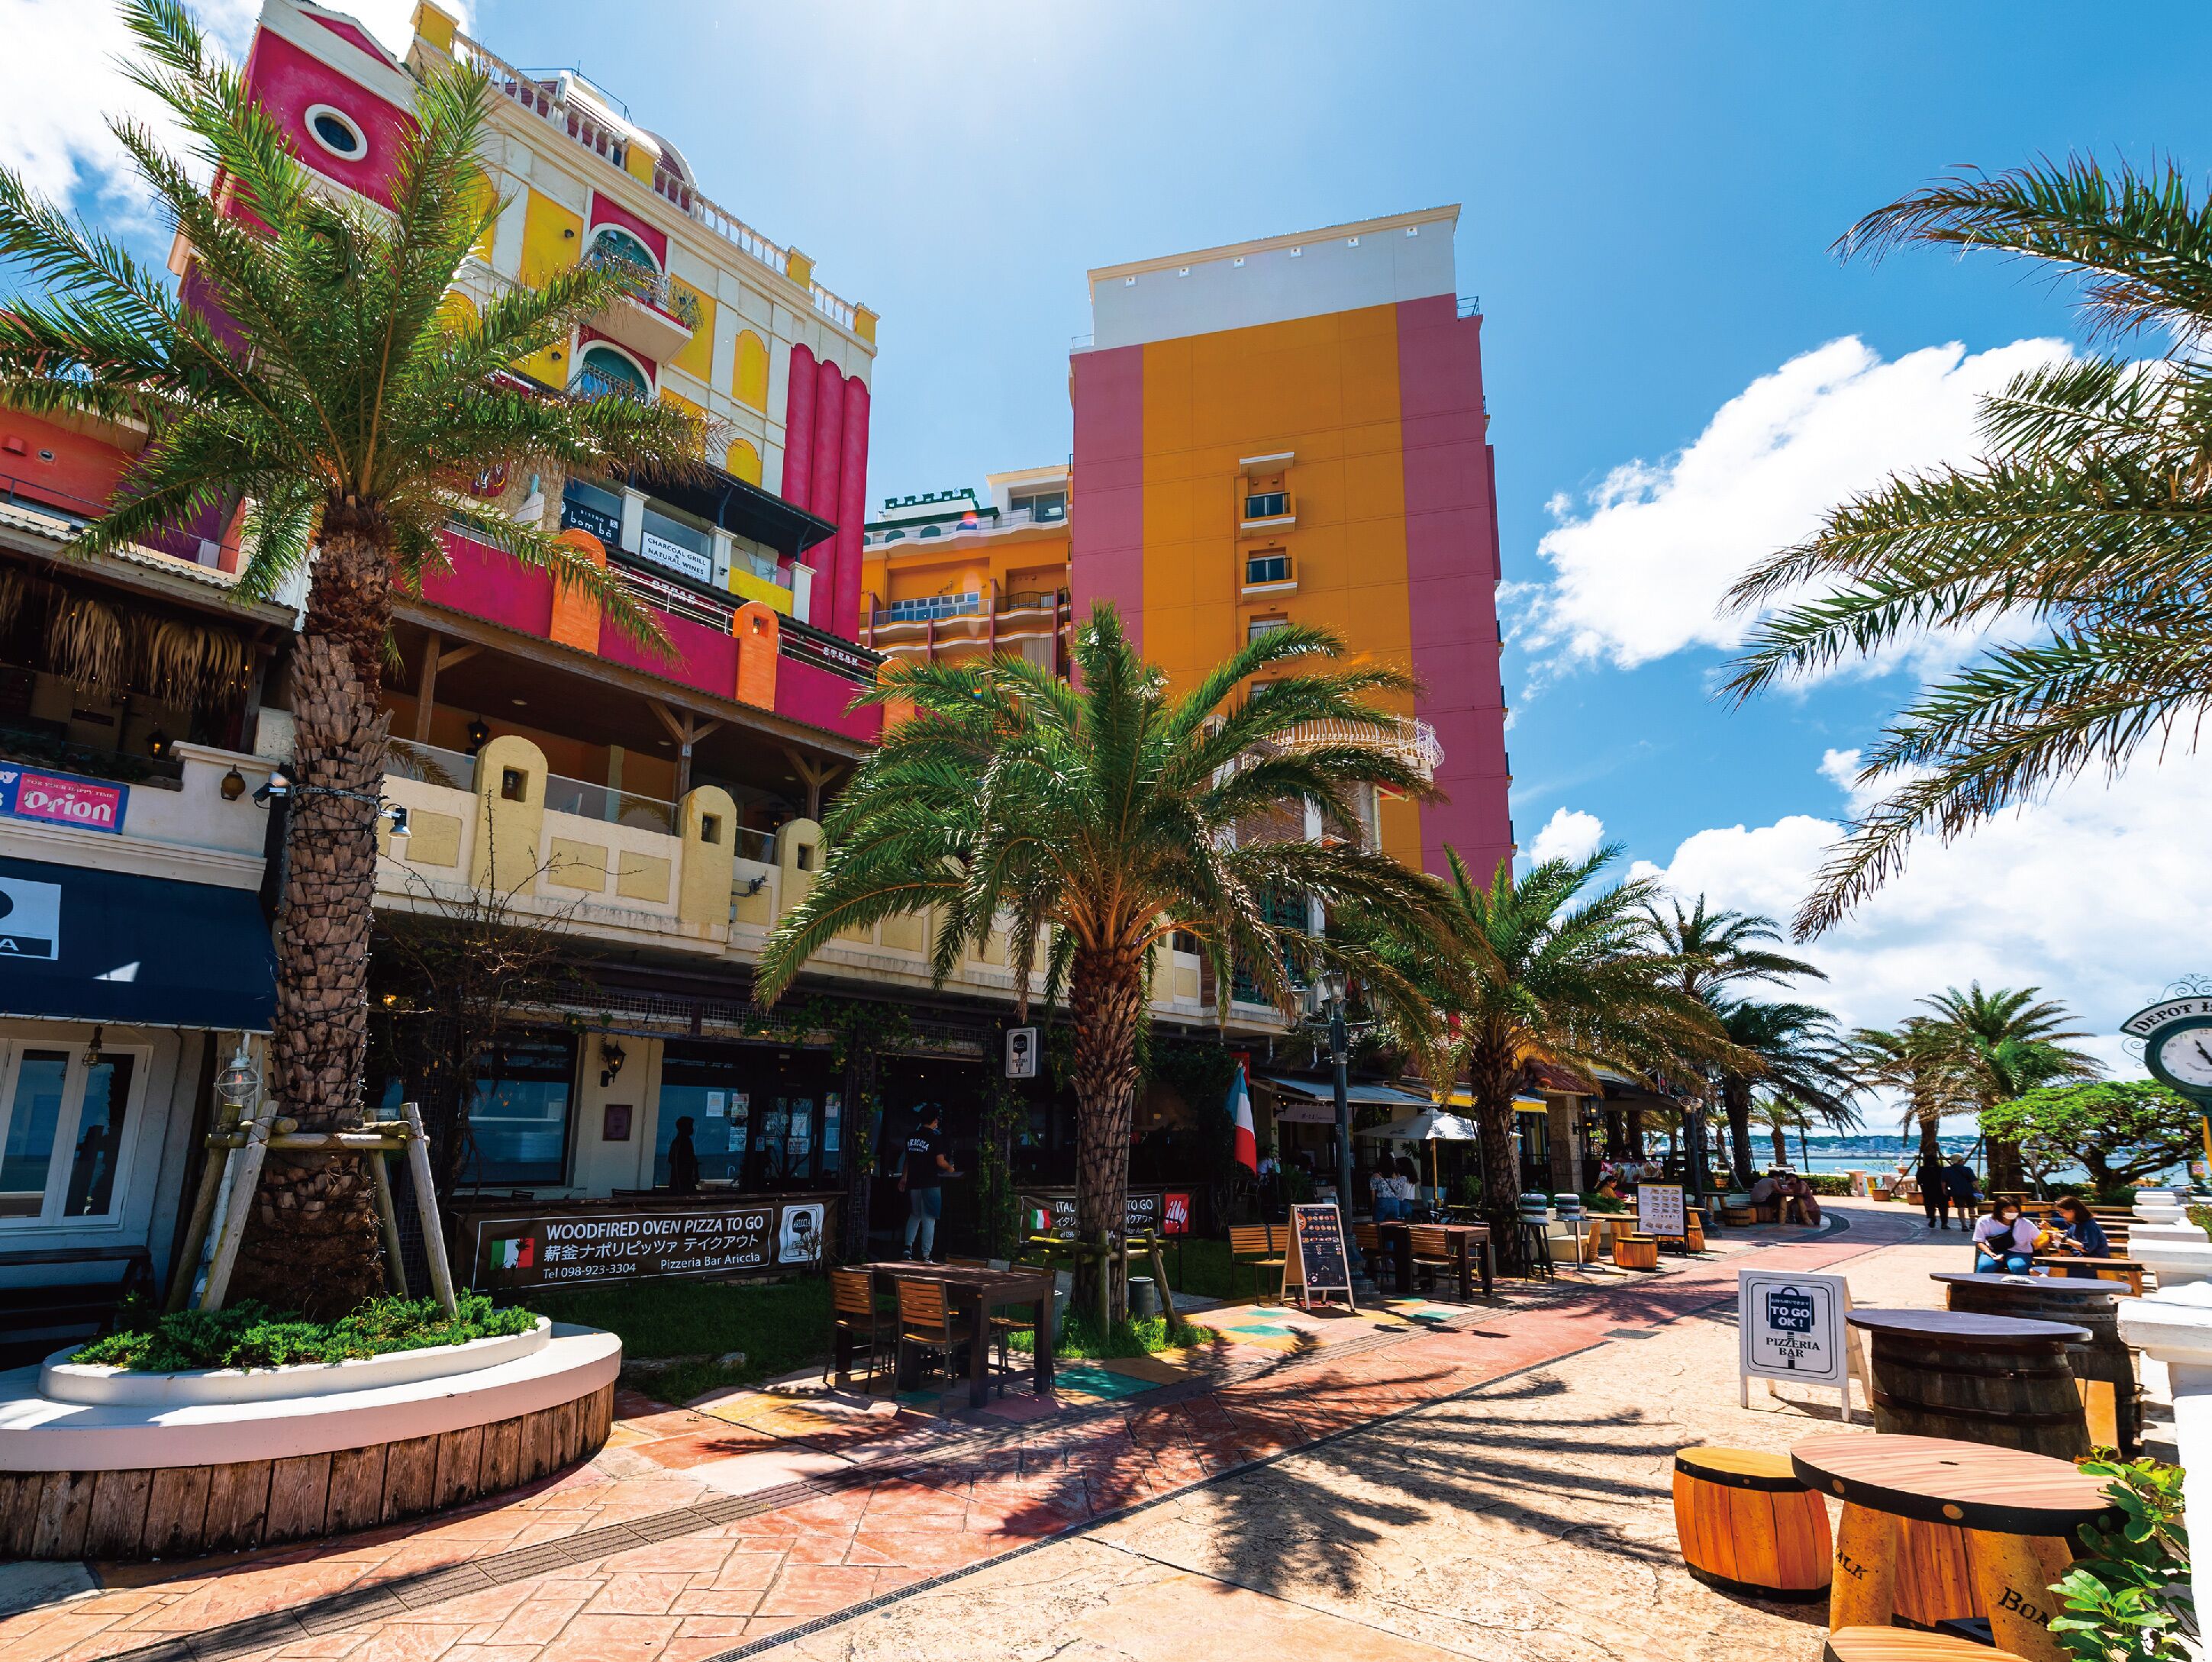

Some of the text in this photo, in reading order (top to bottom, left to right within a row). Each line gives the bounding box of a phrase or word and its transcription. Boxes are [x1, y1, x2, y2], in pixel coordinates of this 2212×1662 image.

[570, 511, 594, 530] bom
[647, 537, 706, 566] CHARCOAL GRILL
[648, 547, 704, 575] NATURAL WINES
[823, 646, 858, 666] STEAK
[44, 782, 66, 791] YOUR
[24, 791, 111, 822] Orion
[2133, 1003, 2192, 1032] DEPOT
[1127, 1200, 1138, 1211] TO
[1140, 1199, 1153, 1210] GO
[547, 1215, 763, 1240] WOODFIRED OVEN PIZZA TO GO
[543, 1233, 759, 1262] 薪釜ナポリピッツァ テイクアウト
[543, 1251, 760, 1280] Tel 098-923-3304 Pizzeria Bar Ariccia
[1771, 1306, 1810, 1318] TO GO
[1765, 1336, 1820, 1351] PIZZERIA
[1778, 1347, 1804, 1358] BAR
